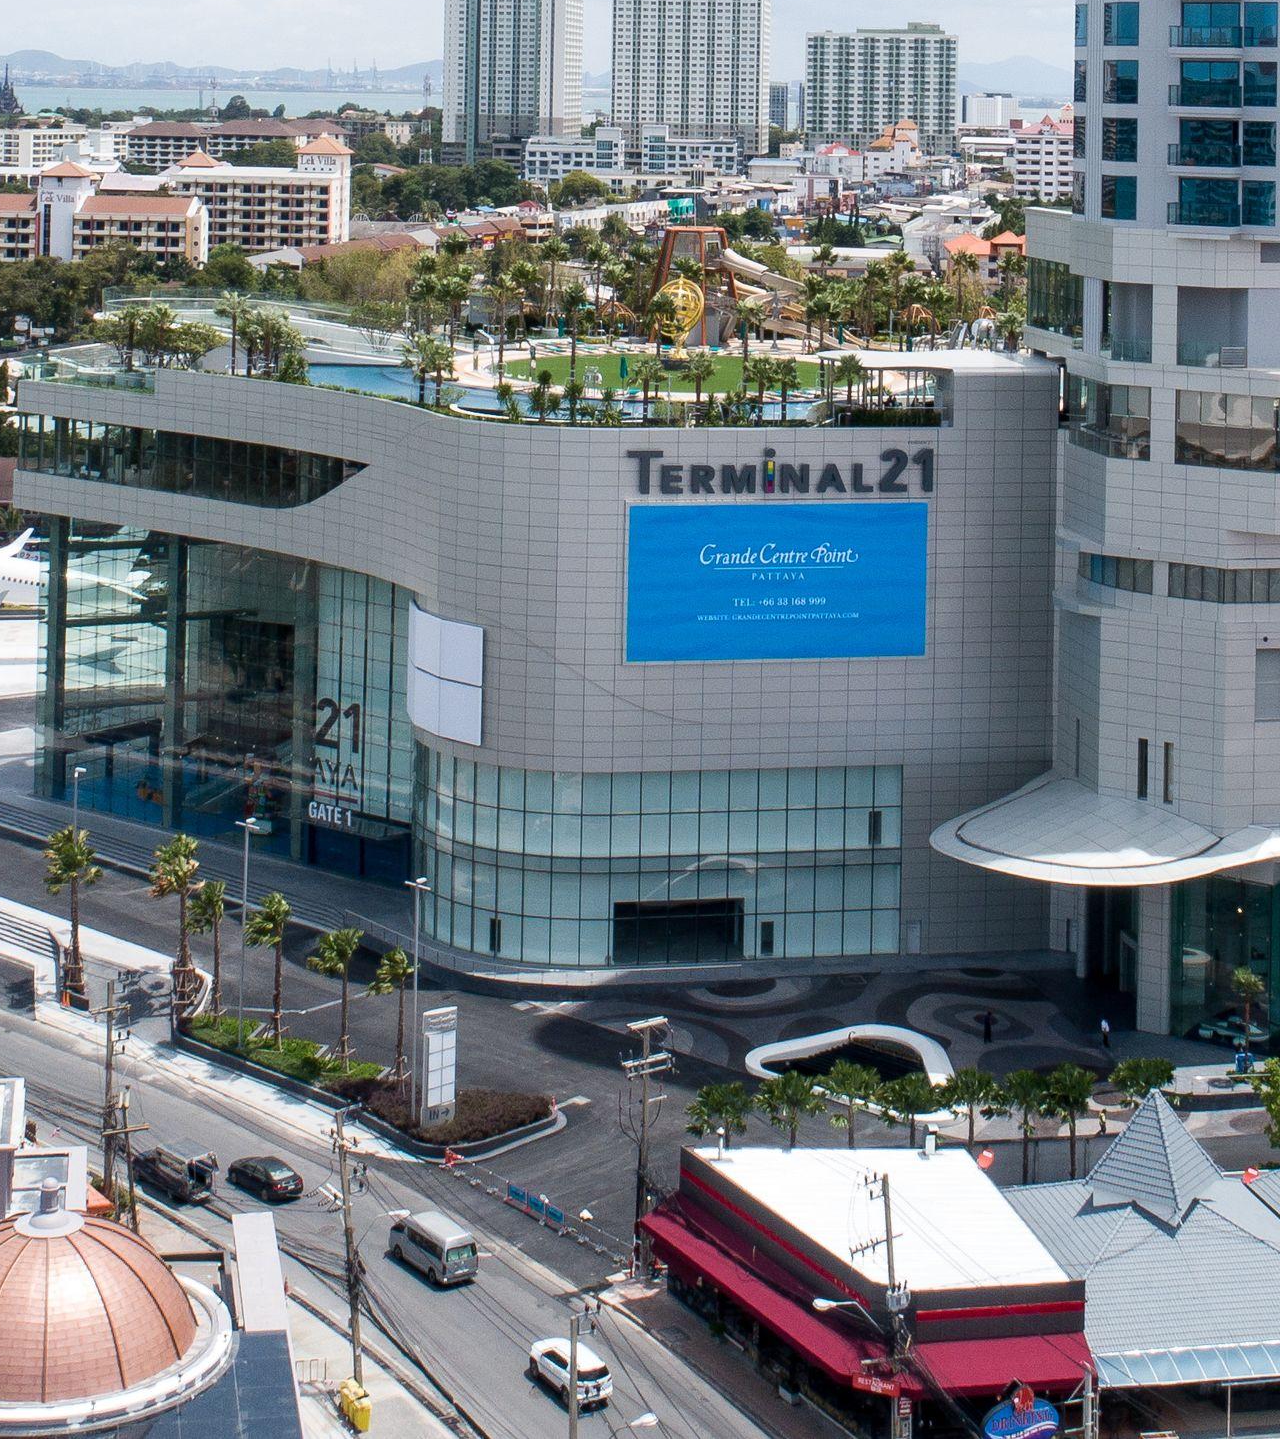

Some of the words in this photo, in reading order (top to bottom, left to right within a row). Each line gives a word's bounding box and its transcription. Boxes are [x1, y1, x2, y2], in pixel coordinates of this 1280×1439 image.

[301, 156, 315, 165] Lek
[317, 156, 336, 165] Villa
[40, 193, 55, 203] Lek
[56, 194, 75, 203] Villa
[699, 543, 757, 565] Grande
[759, 543, 809, 564] Centre
[810, 542, 859, 564] Point
[751, 572, 805, 581] PATTAYA
[732, 597, 756, 607] TEL:
[758, 597, 775, 607] +66
[791, 597, 806, 606] 168
[808, 596, 826, 606] 999
[314, 697, 361, 754] 21
[308, 801, 342, 825] GATE
[345, 809, 352, 827] 1
[429, 1109, 440, 1120] IN
